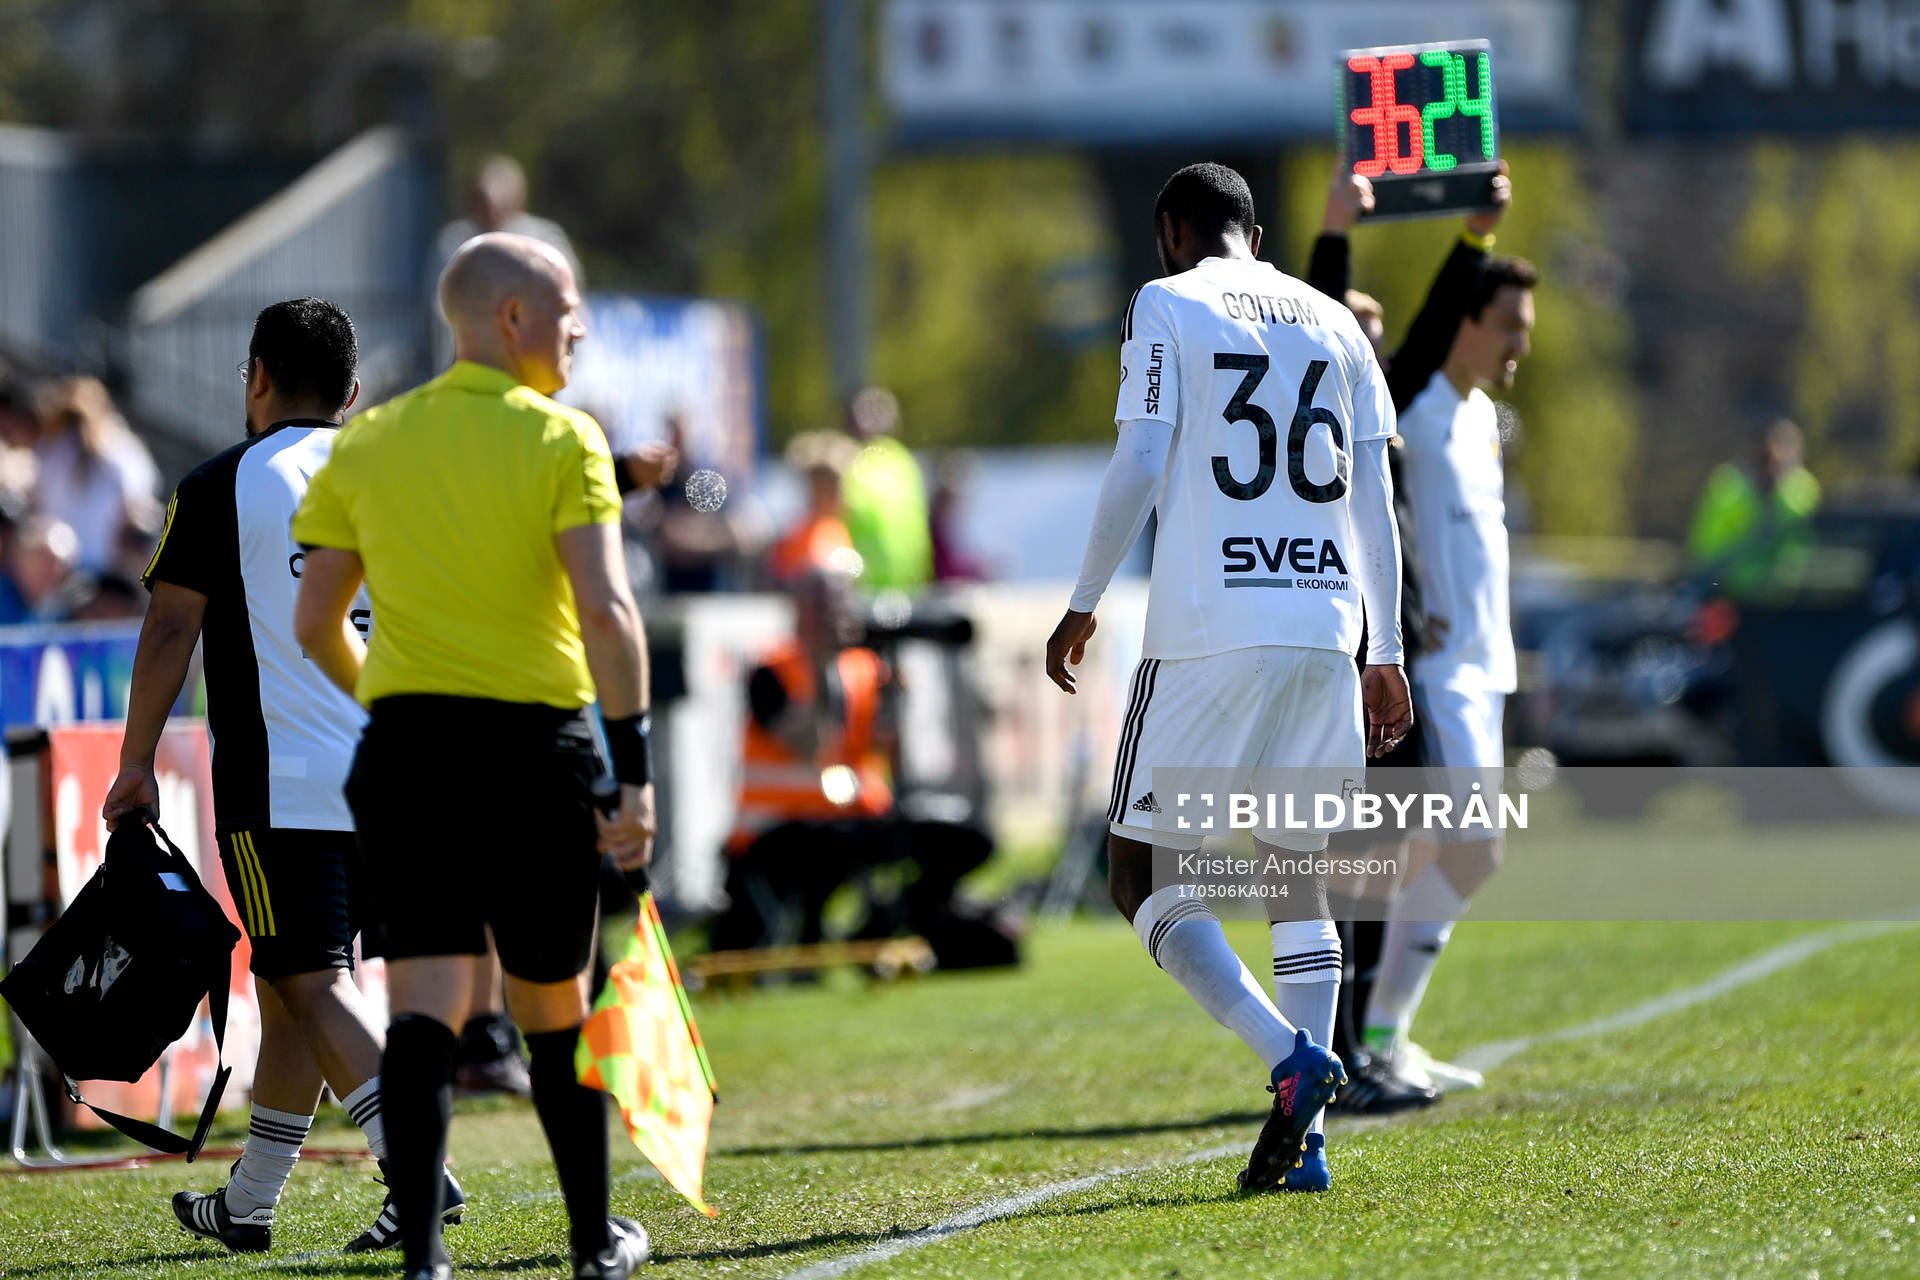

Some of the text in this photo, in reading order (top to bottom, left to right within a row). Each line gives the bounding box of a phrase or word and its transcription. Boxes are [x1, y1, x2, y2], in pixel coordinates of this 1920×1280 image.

[1348, 50, 1495, 177] 36 24
[1222, 292, 1320, 327] GOITOM
[1144, 343, 1164, 415] stadium
[1211, 353, 1348, 503] 36
[1222, 537, 1348, 575] SVEA
[1296, 578, 1349, 591] EKONOMI
[1132, 803, 1162, 813] adidas
